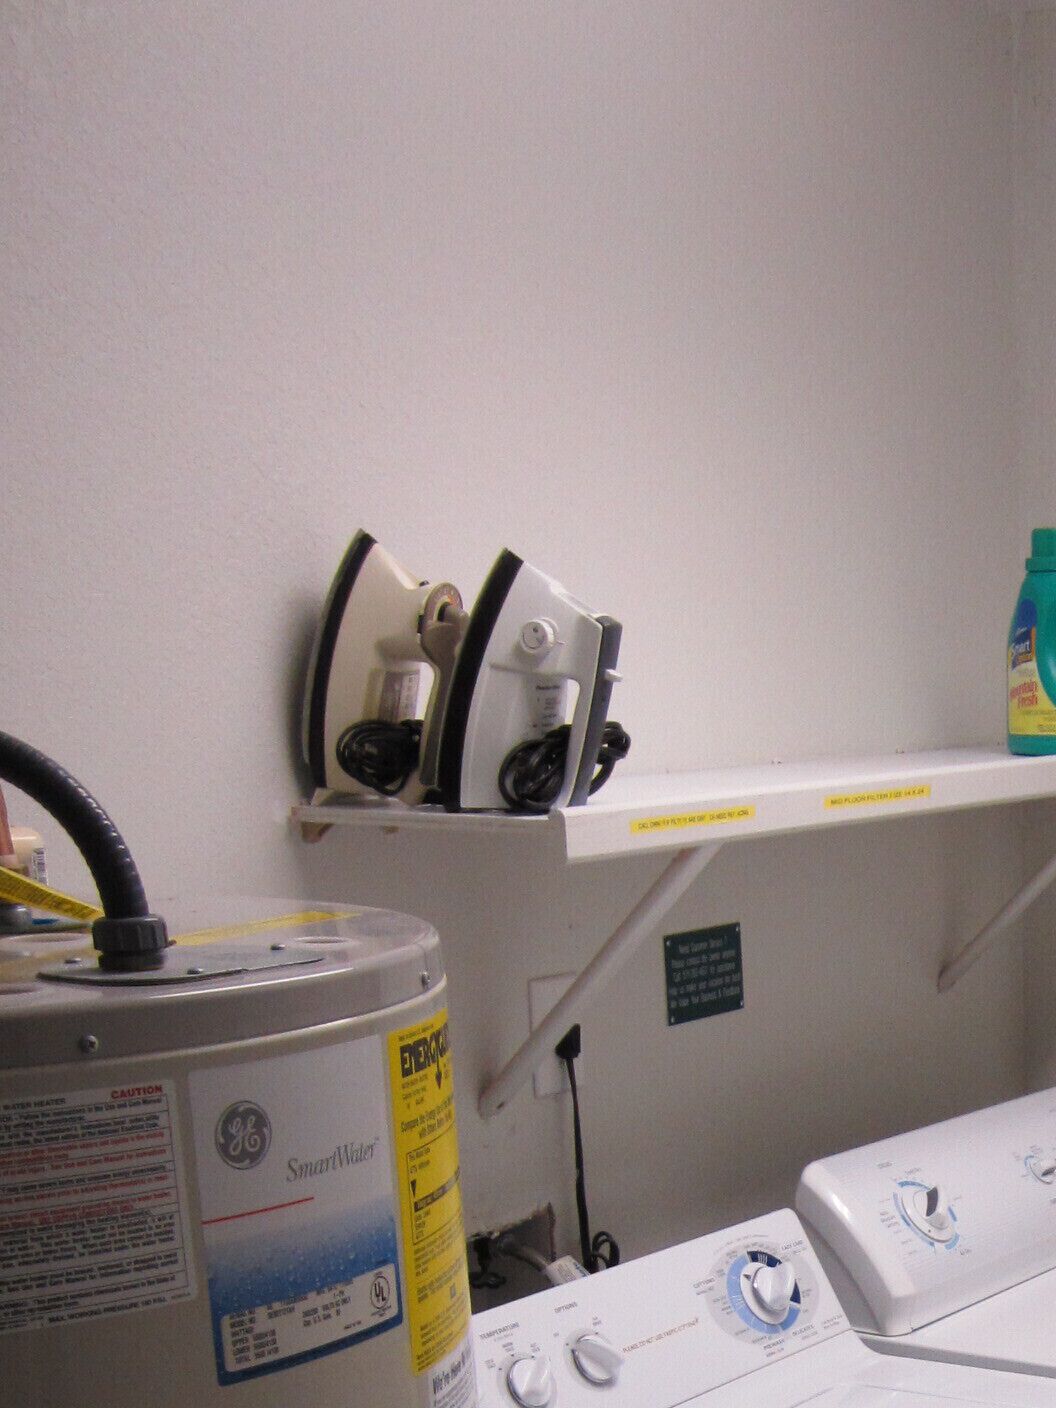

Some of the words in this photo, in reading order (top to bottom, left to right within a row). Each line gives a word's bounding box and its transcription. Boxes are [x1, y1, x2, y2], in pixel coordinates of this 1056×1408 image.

[111, 1084, 163, 1099] CAUTION
[33, 1098, 66, 1108] HEATER
[286, 1141, 376, 1183] SmartWater
[68, 1310, 100, 1320] WORKING
[103, 1302, 139, 1313] PRESSURE
[554, 1301, 578, 1314] OPTIONS
[480, 1321, 519, 1340] TEMPERATURE
